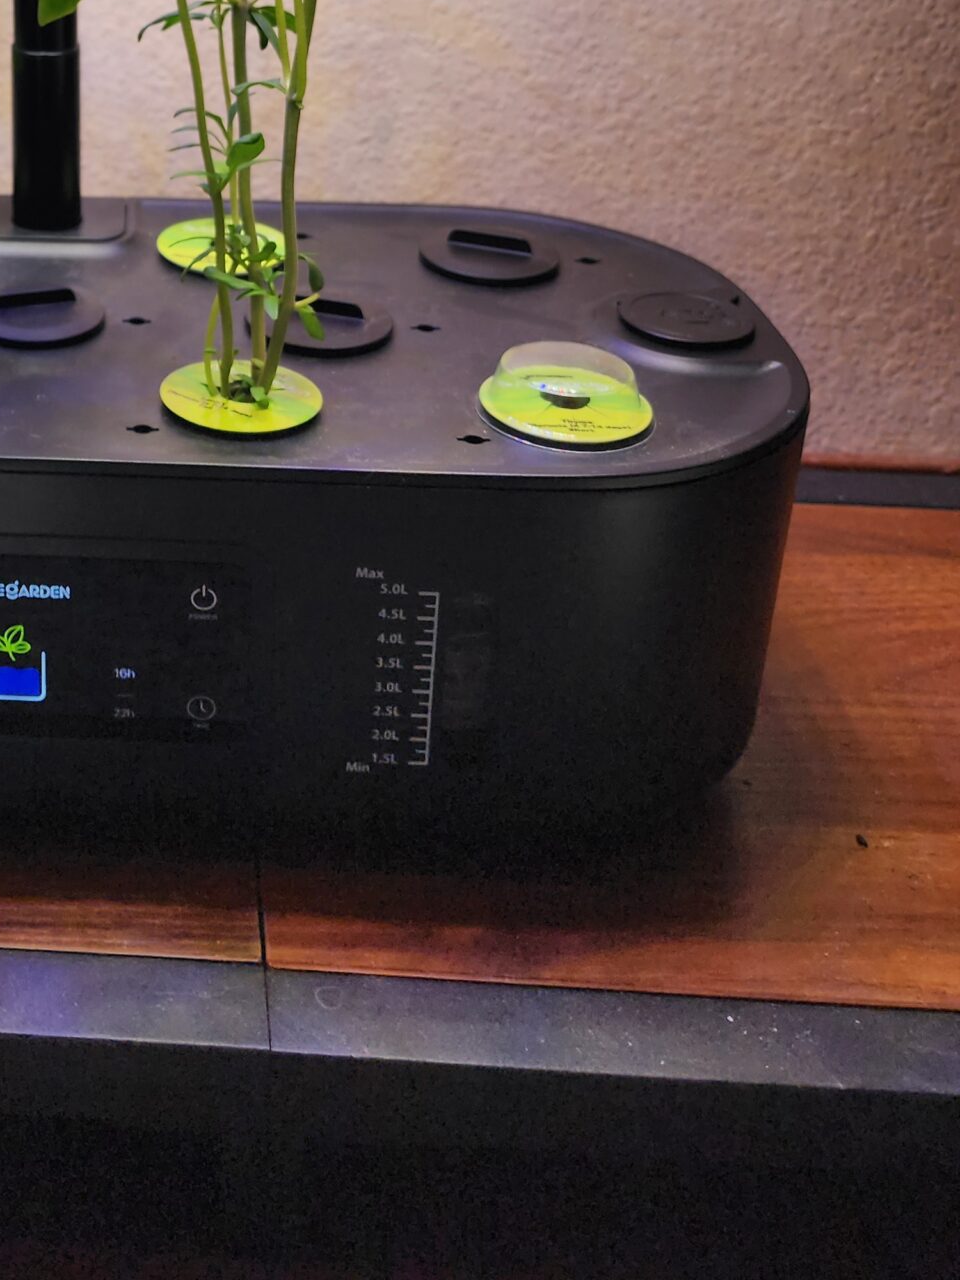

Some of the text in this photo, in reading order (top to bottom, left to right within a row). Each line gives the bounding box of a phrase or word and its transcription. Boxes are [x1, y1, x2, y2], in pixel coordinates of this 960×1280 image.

[355, 567, 385, 580] Max
[380, 583, 408, 595] 5.0L
[378, 608, 407, 620] 4.5L
[376, 633, 405, 645] 4.0L
[375, 657, 403, 669] 3.5L
[113, 667, 136, 680] 16h
[374, 681, 402, 693] 3.0L
[372, 705, 400, 717] 2.5L
[371, 729, 399, 741] 2.0L
[371, 753, 397, 765] 1.5L
[345, 761, 370, 773] Min
